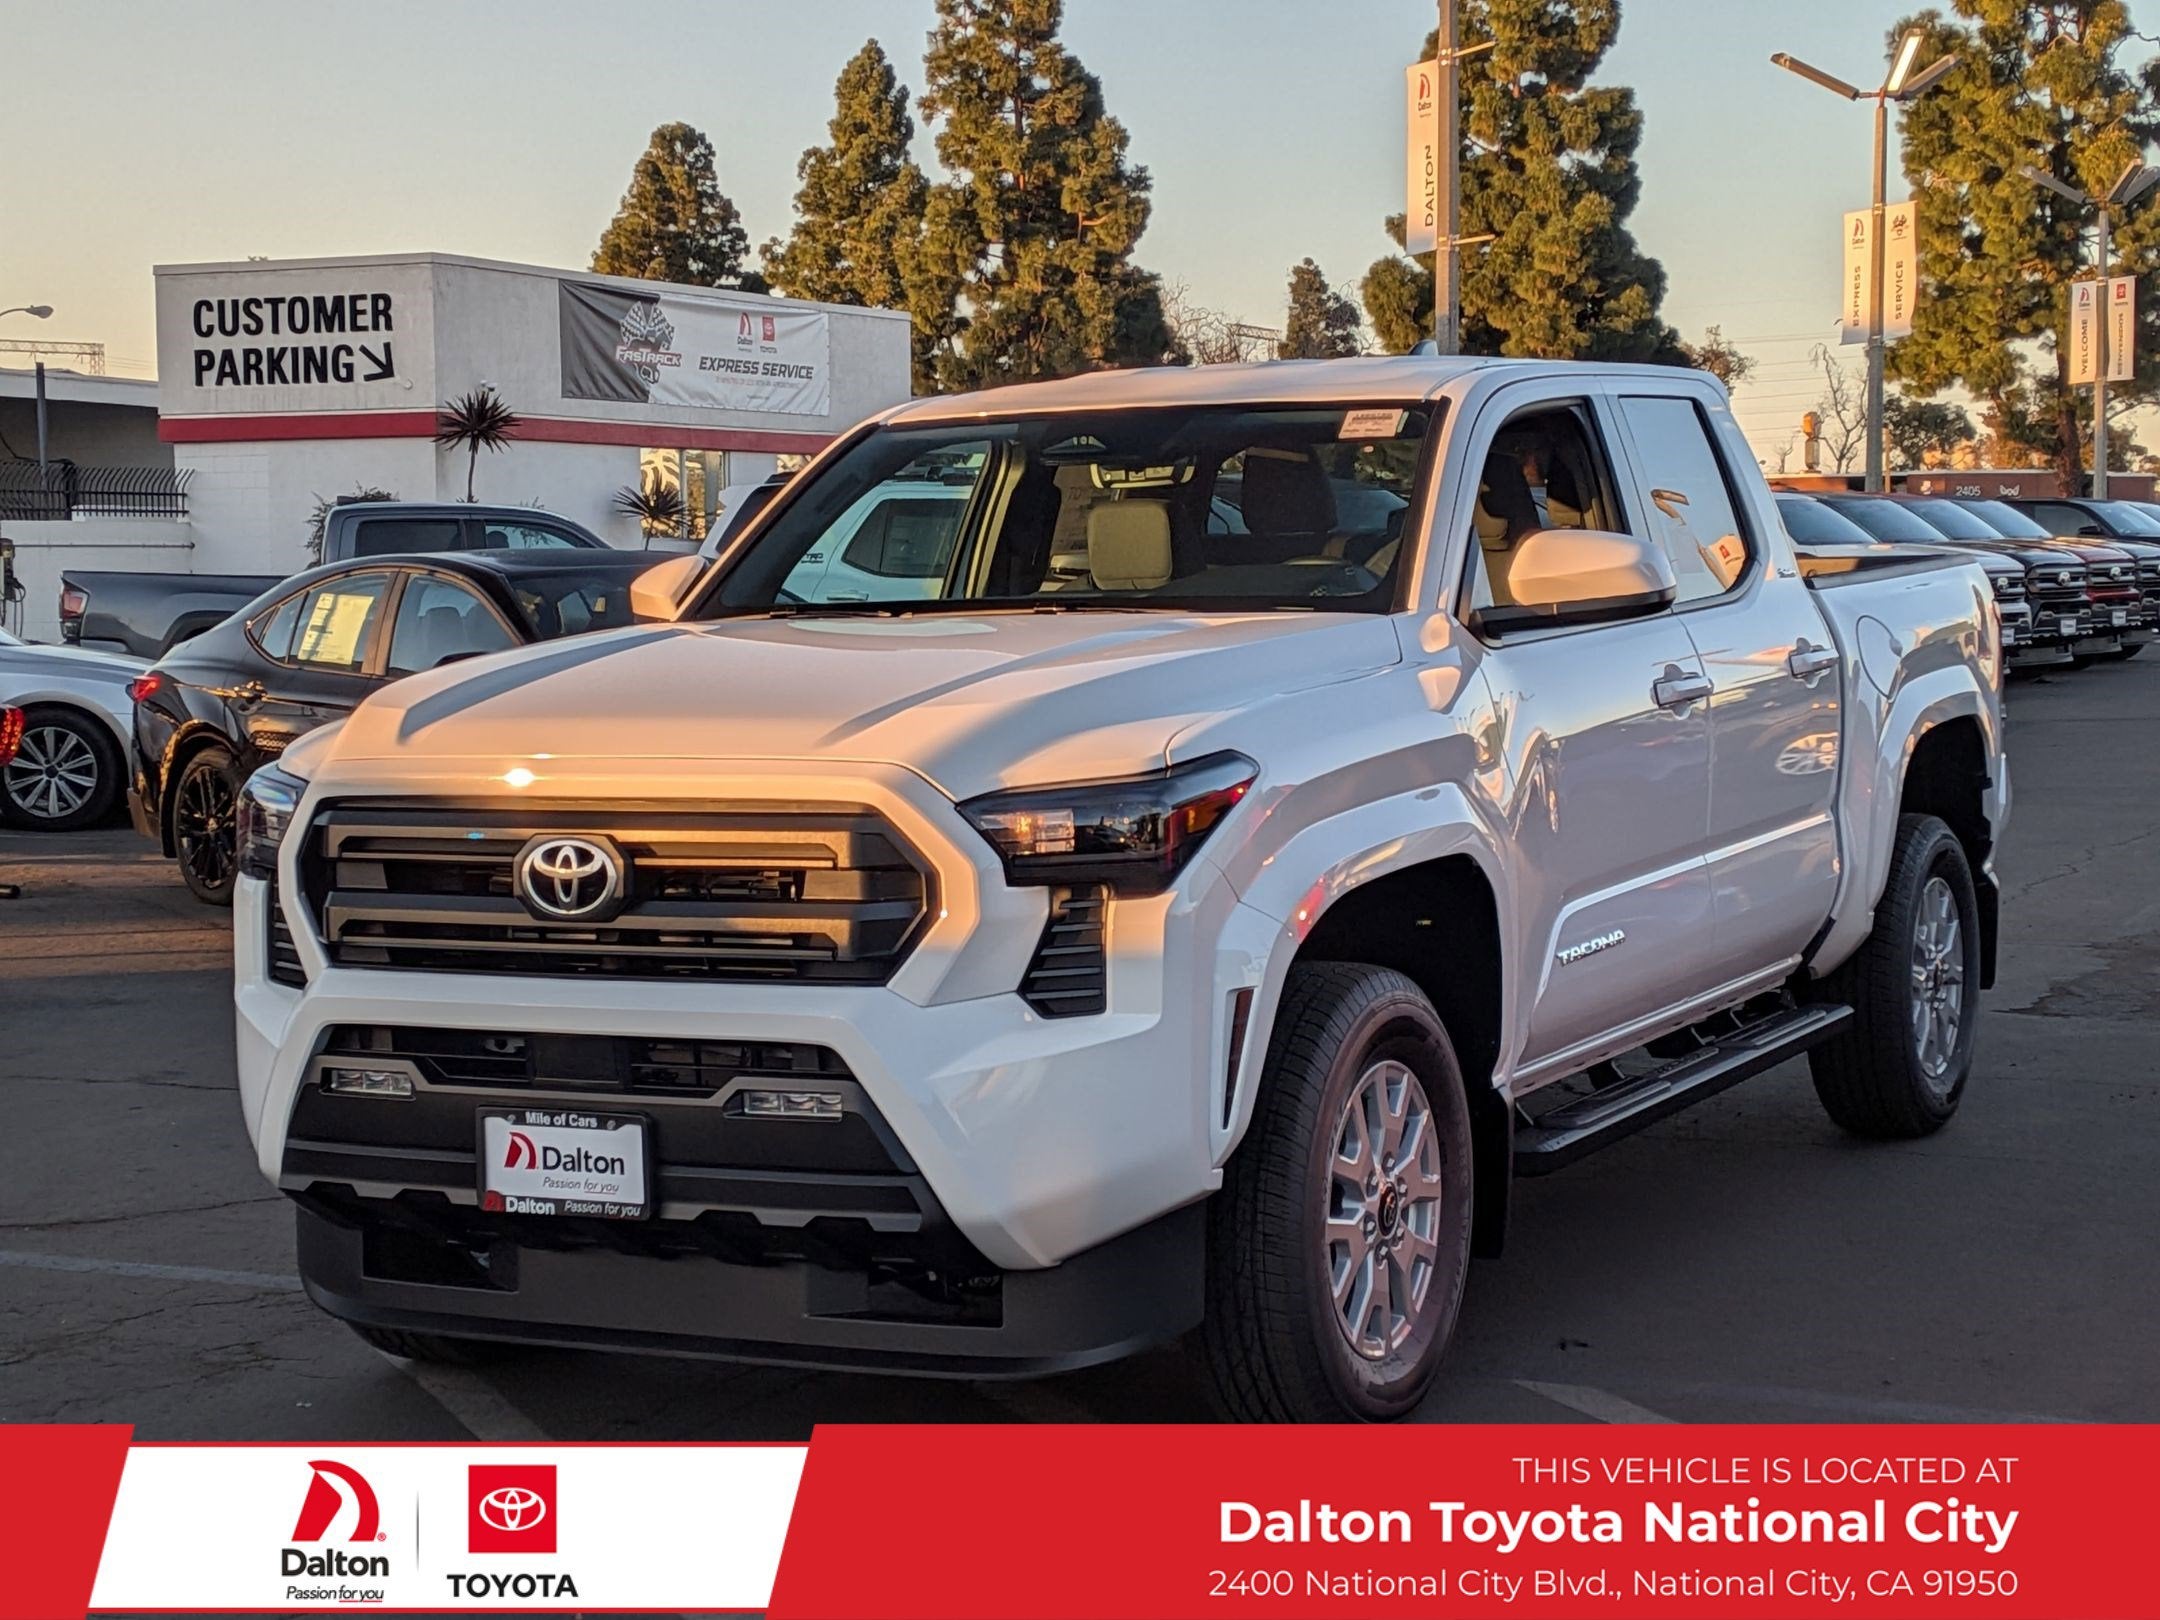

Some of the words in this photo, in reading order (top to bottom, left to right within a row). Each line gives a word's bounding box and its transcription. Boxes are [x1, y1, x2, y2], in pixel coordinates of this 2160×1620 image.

[1425, 145, 1434, 227] DALTON
[1852, 265, 1861, 327] EXPRESS
[1895, 260, 1904, 320] SERVICE
[193, 292, 394, 338] CUSTOMER
[194, 343, 355, 387] PARKING
[2081, 319, 2089, 375] WELCOME
[699, 356, 760, 375] EXPRESS
[761, 362, 814, 380] SERVICE
[1955, 485, 1982, 497] 2405
[1556, 929, 1627, 967] TACOMA
[525, 1111, 551, 1125] Mile
[553, 1113, 567, 1126] of
[568, 1114, 598, 1128] Cars
[542, 1146, 625, 1175] Dalton
[542, 1176, 581, 1190] Passion
[584, 1179, 599, 1192] for
[600, 1183, 620, 1194] you
[505, 1196, 556, 1216] Dalton
[563, 1200, 602, 1215] Passion
[604, 1203, 618, 1215] for
[621, 1205, 641, 1218] you
